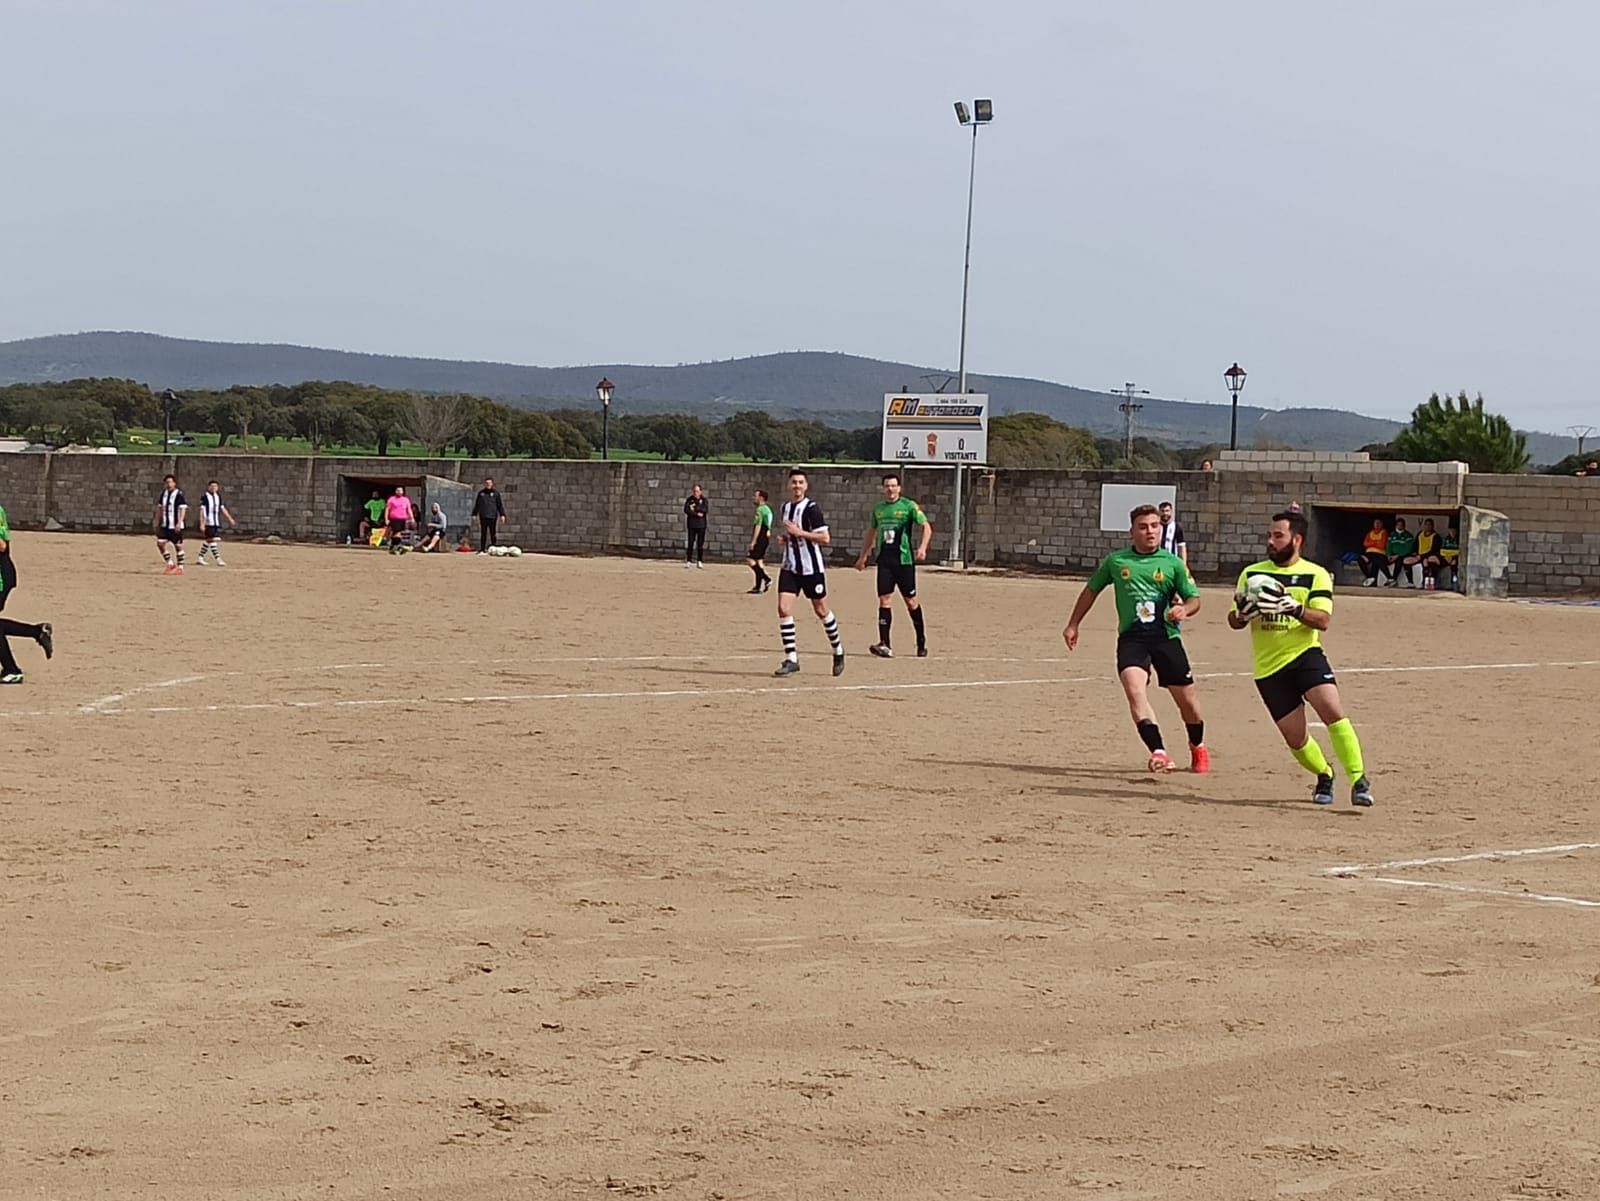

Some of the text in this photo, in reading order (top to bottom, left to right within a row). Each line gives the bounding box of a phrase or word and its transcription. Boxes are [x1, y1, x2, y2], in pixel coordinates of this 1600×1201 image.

[903, 437, 909, 449] 2
[958, 438, 965, 450] 0
[895, 450, 916, 459] LOCAL
[944, 451, 977, 460] VISITANTE
